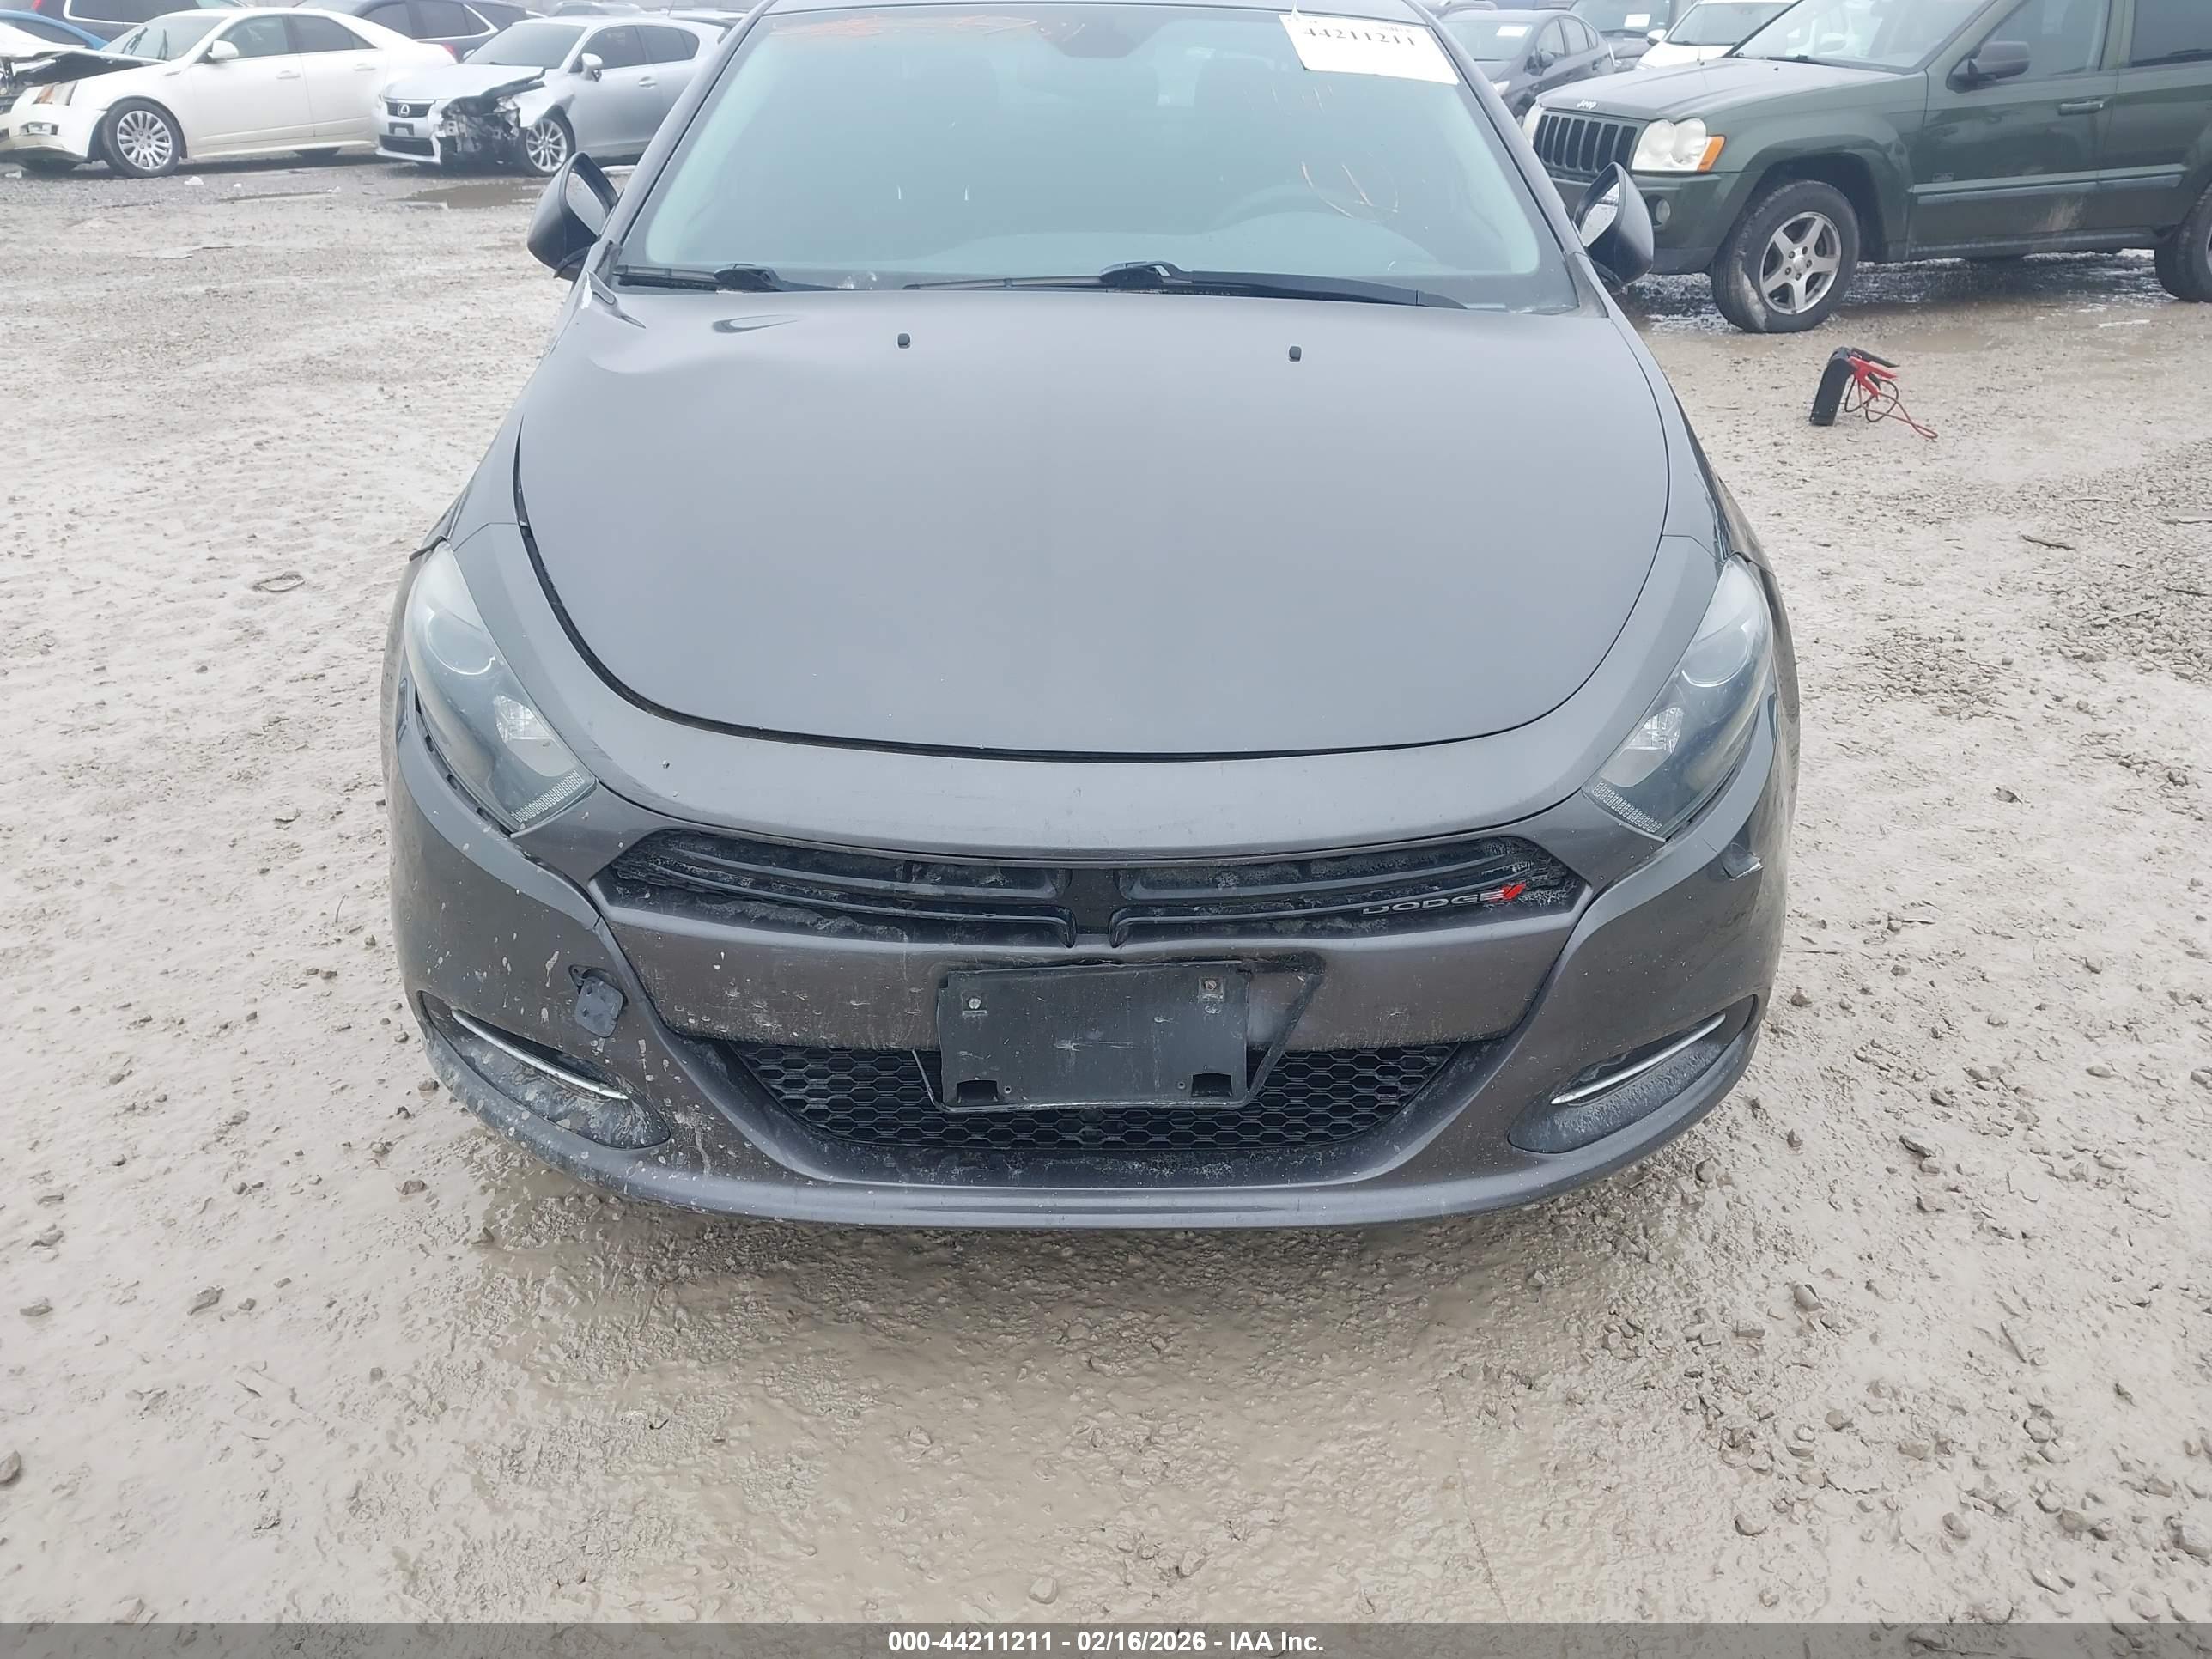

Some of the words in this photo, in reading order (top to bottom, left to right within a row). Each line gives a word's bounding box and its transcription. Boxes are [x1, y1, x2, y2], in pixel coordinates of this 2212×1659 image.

[1304, 28, 1415, 46] 44211211
[1577, 99, 1597, 110] Jeep
[1362, 888, 1505, 915] DODGE
